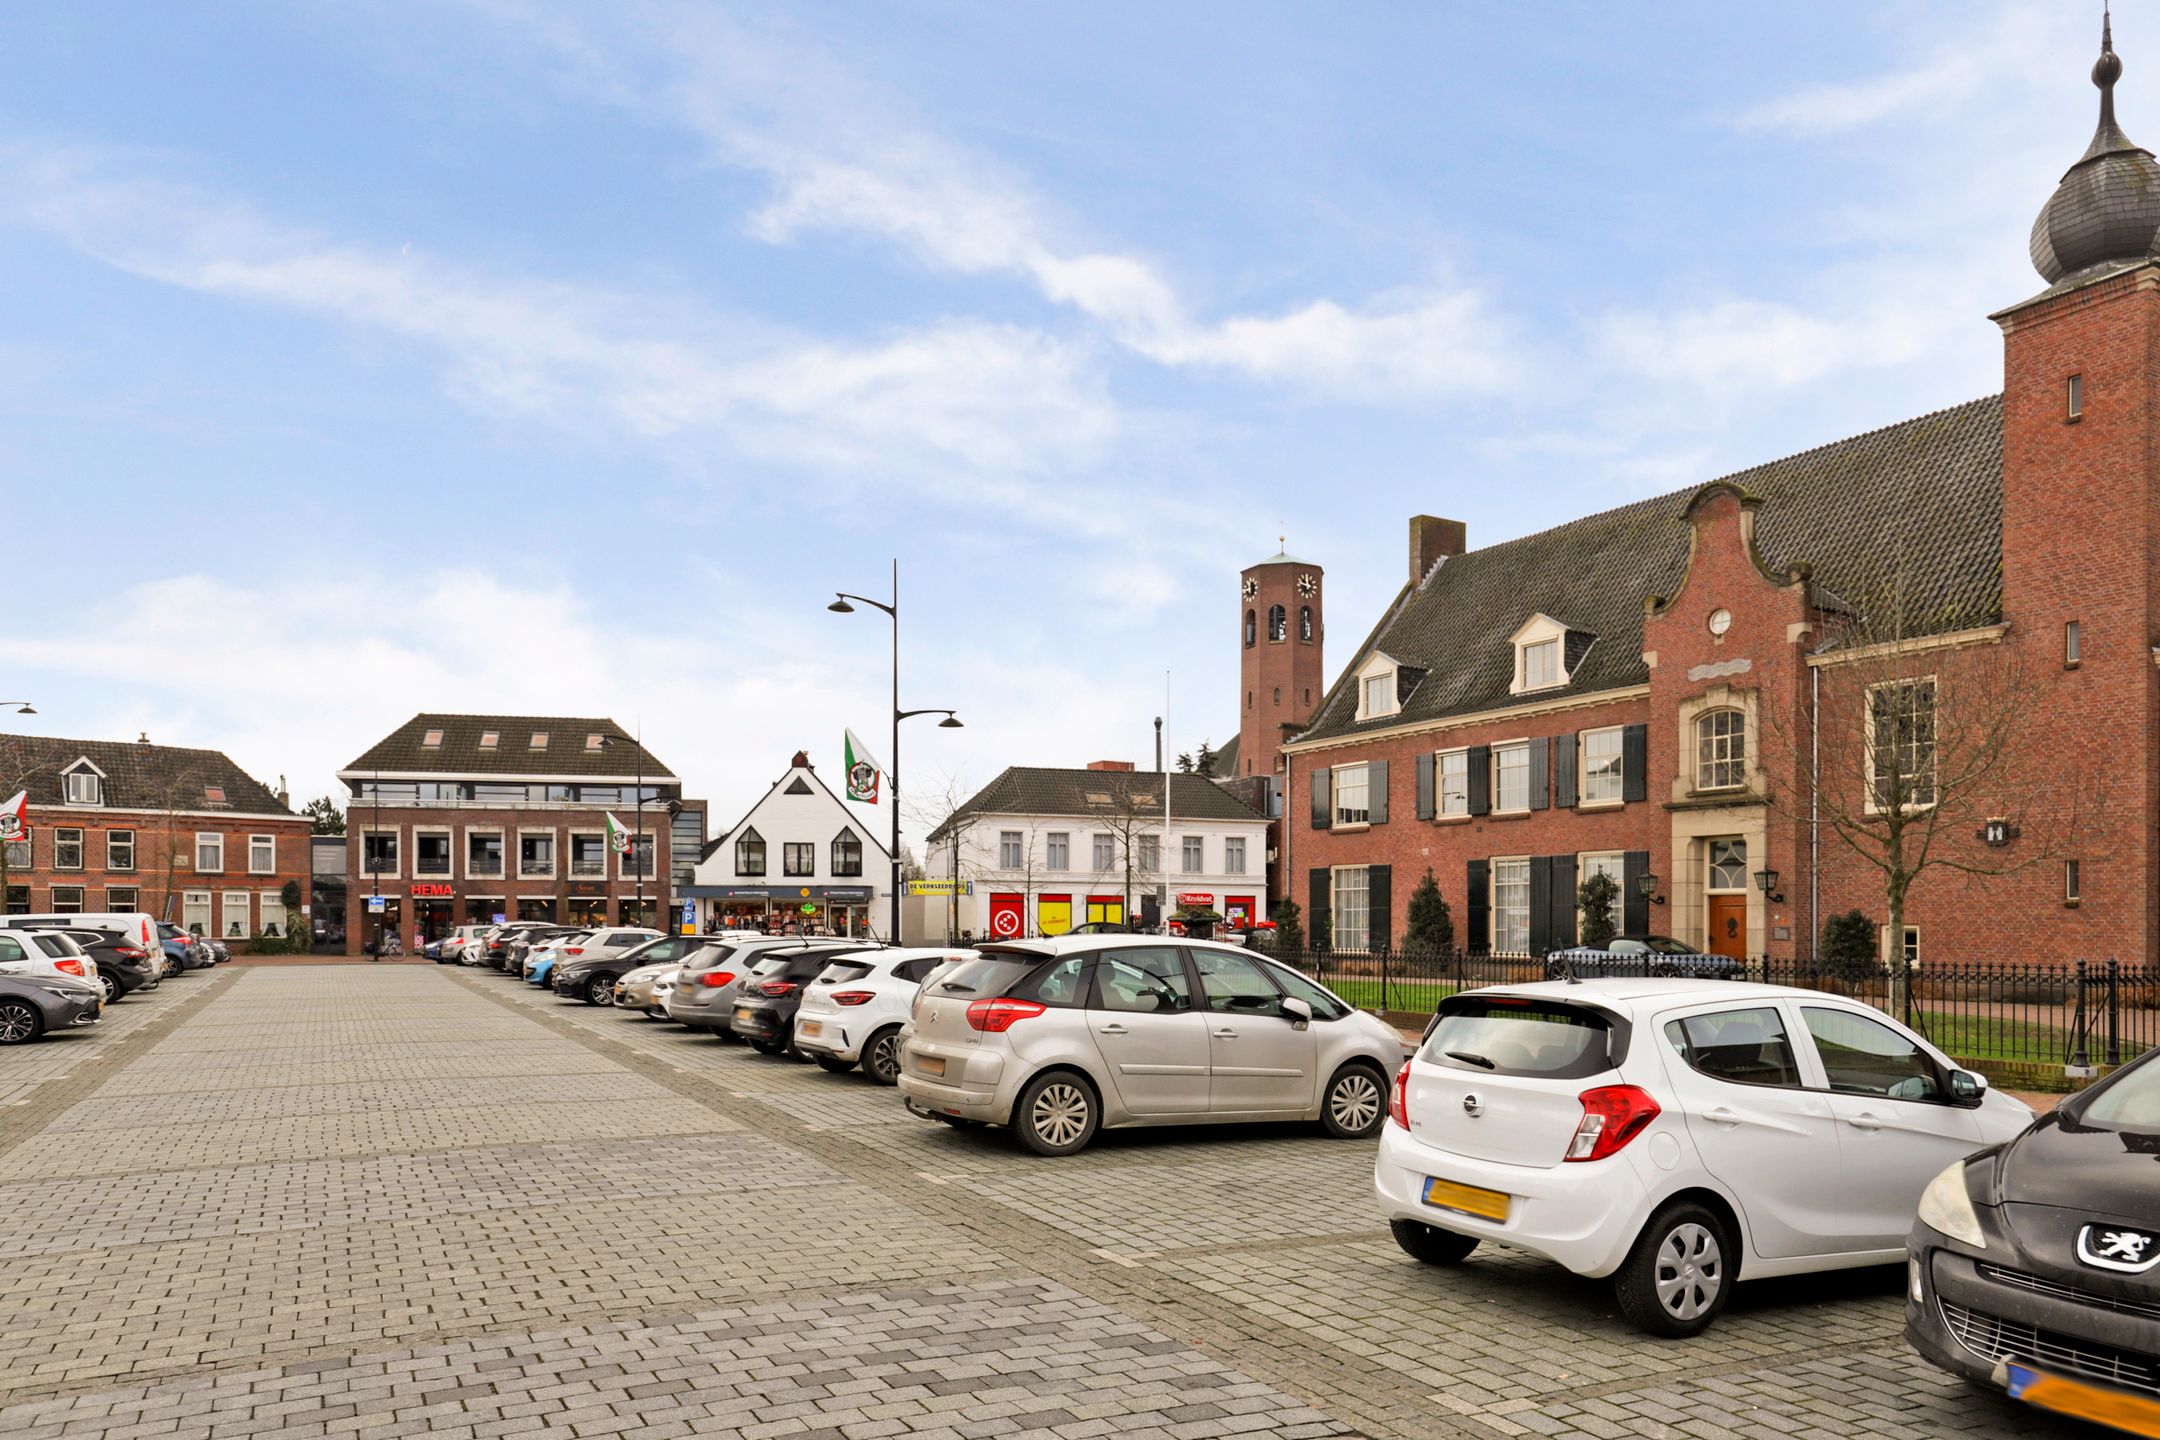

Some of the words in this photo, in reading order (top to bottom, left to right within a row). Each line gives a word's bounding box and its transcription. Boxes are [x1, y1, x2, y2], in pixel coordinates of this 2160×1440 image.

[411, 883, 454, 896] HEMA
[1186, 895, 1213, 903] Kruidvat
[685, 913, 692, 923] P
